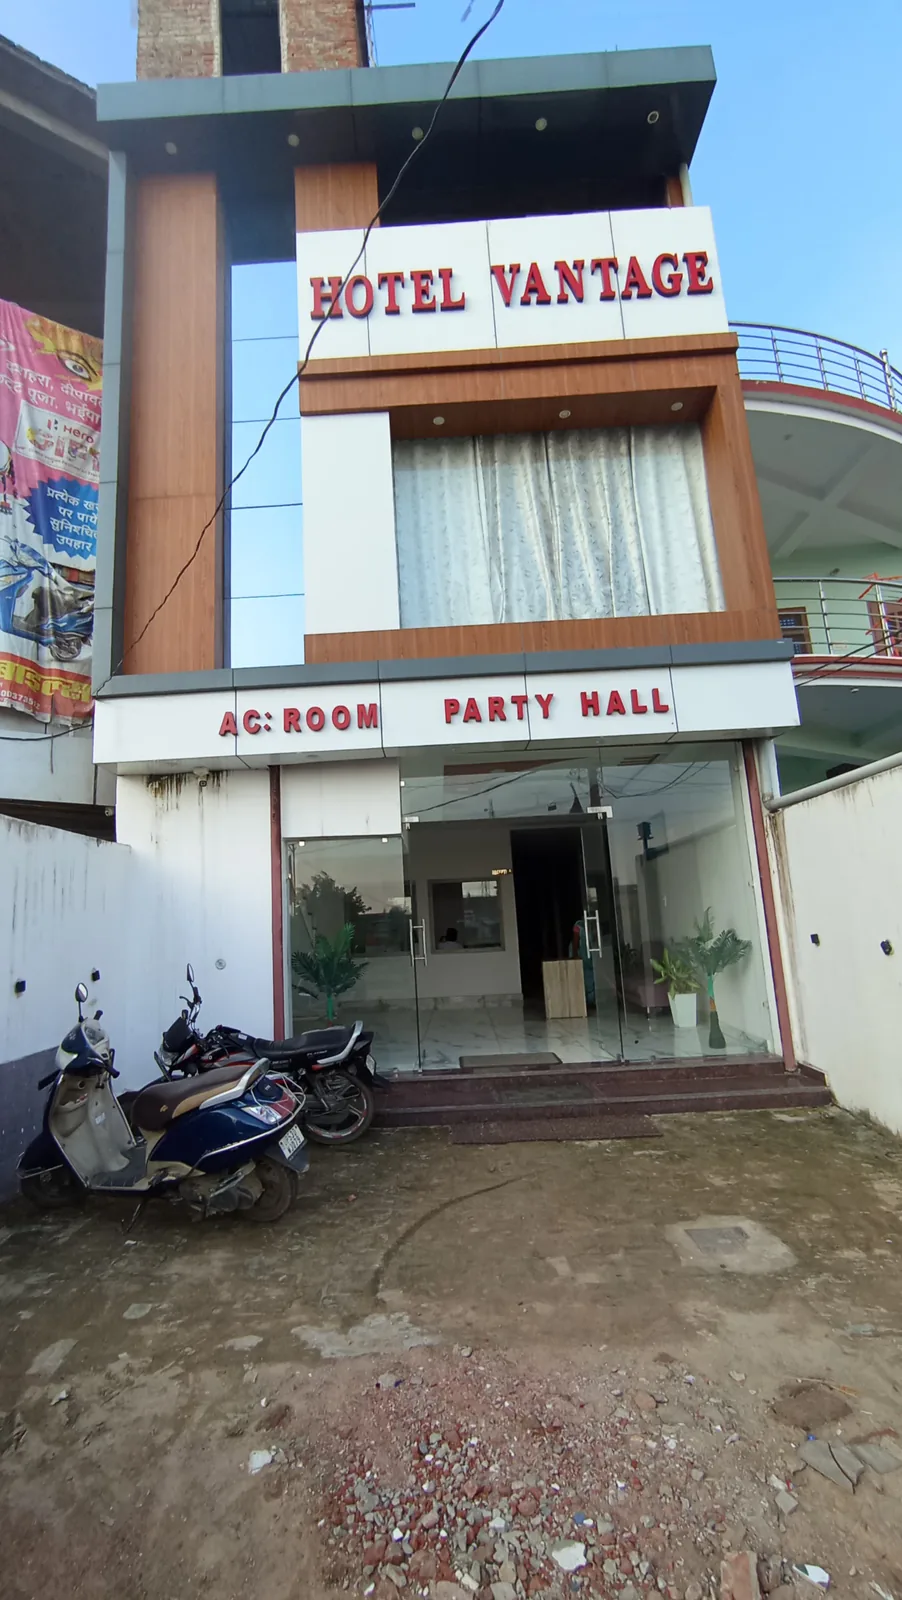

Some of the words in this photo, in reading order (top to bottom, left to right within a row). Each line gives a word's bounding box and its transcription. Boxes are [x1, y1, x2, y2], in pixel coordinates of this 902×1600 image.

[310, 268, 466, 320] HOTEL
[490, 251, 714, 307] VANTAGE
[63, 425, 94, 443] Hero
[47, 486, 80, 507] प्रत्येक
[58, 505, 73, 519] पर
[56, 534, 92, 552] उपहार
[444, 693, 554, 724] PARTY
[580, 687, 669, 717] HALL
[283, 703, 378, 733] ROOM
